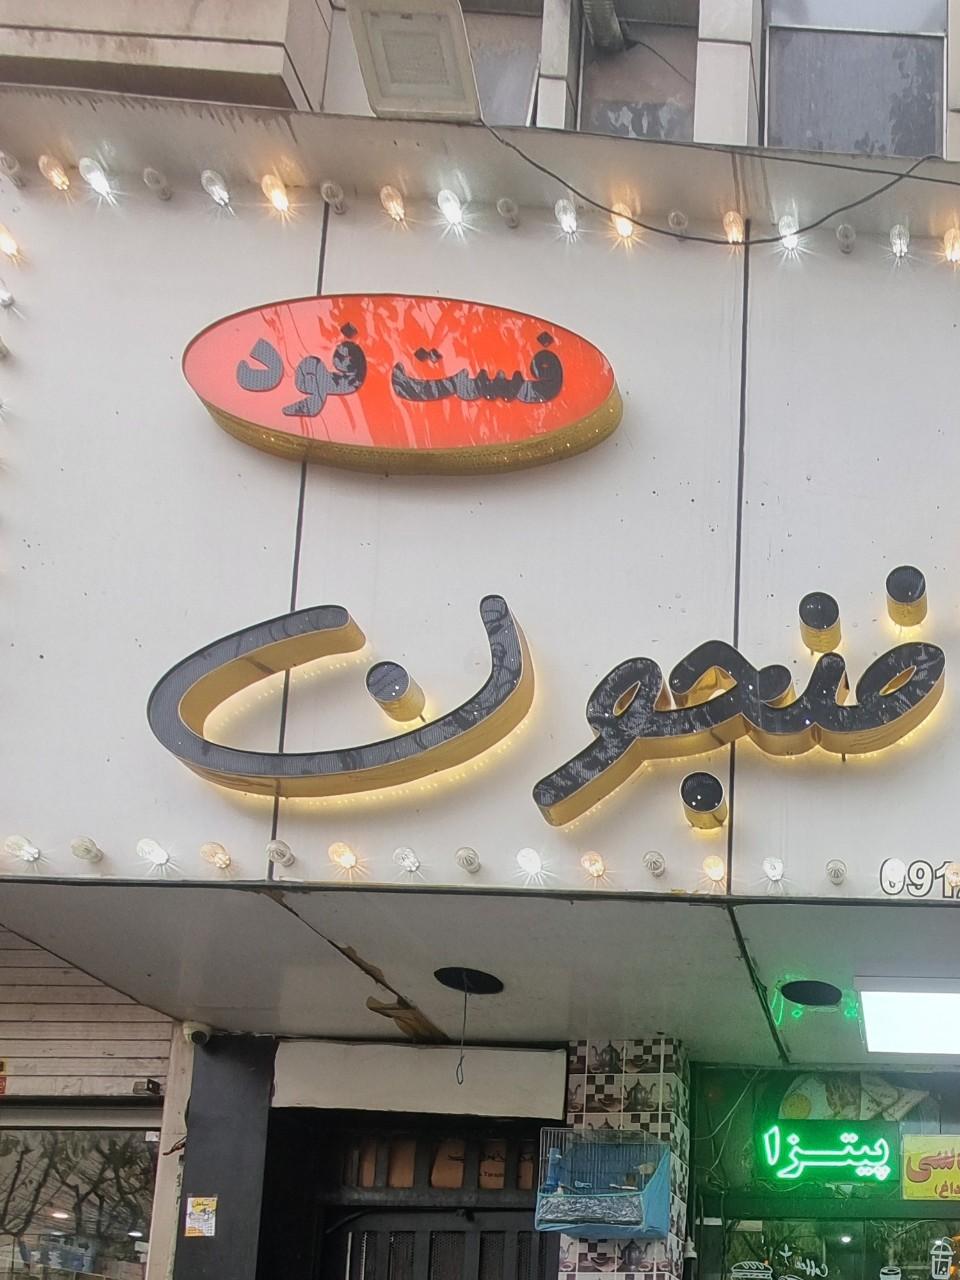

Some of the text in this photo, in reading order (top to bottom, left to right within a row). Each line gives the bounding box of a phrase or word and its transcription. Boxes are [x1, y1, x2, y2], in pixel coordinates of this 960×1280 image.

[236, 322, 563, 418] فست فود
[147, 566, 946, 828] فنجون
[764, 1125, 892, 1180] پیتزا
